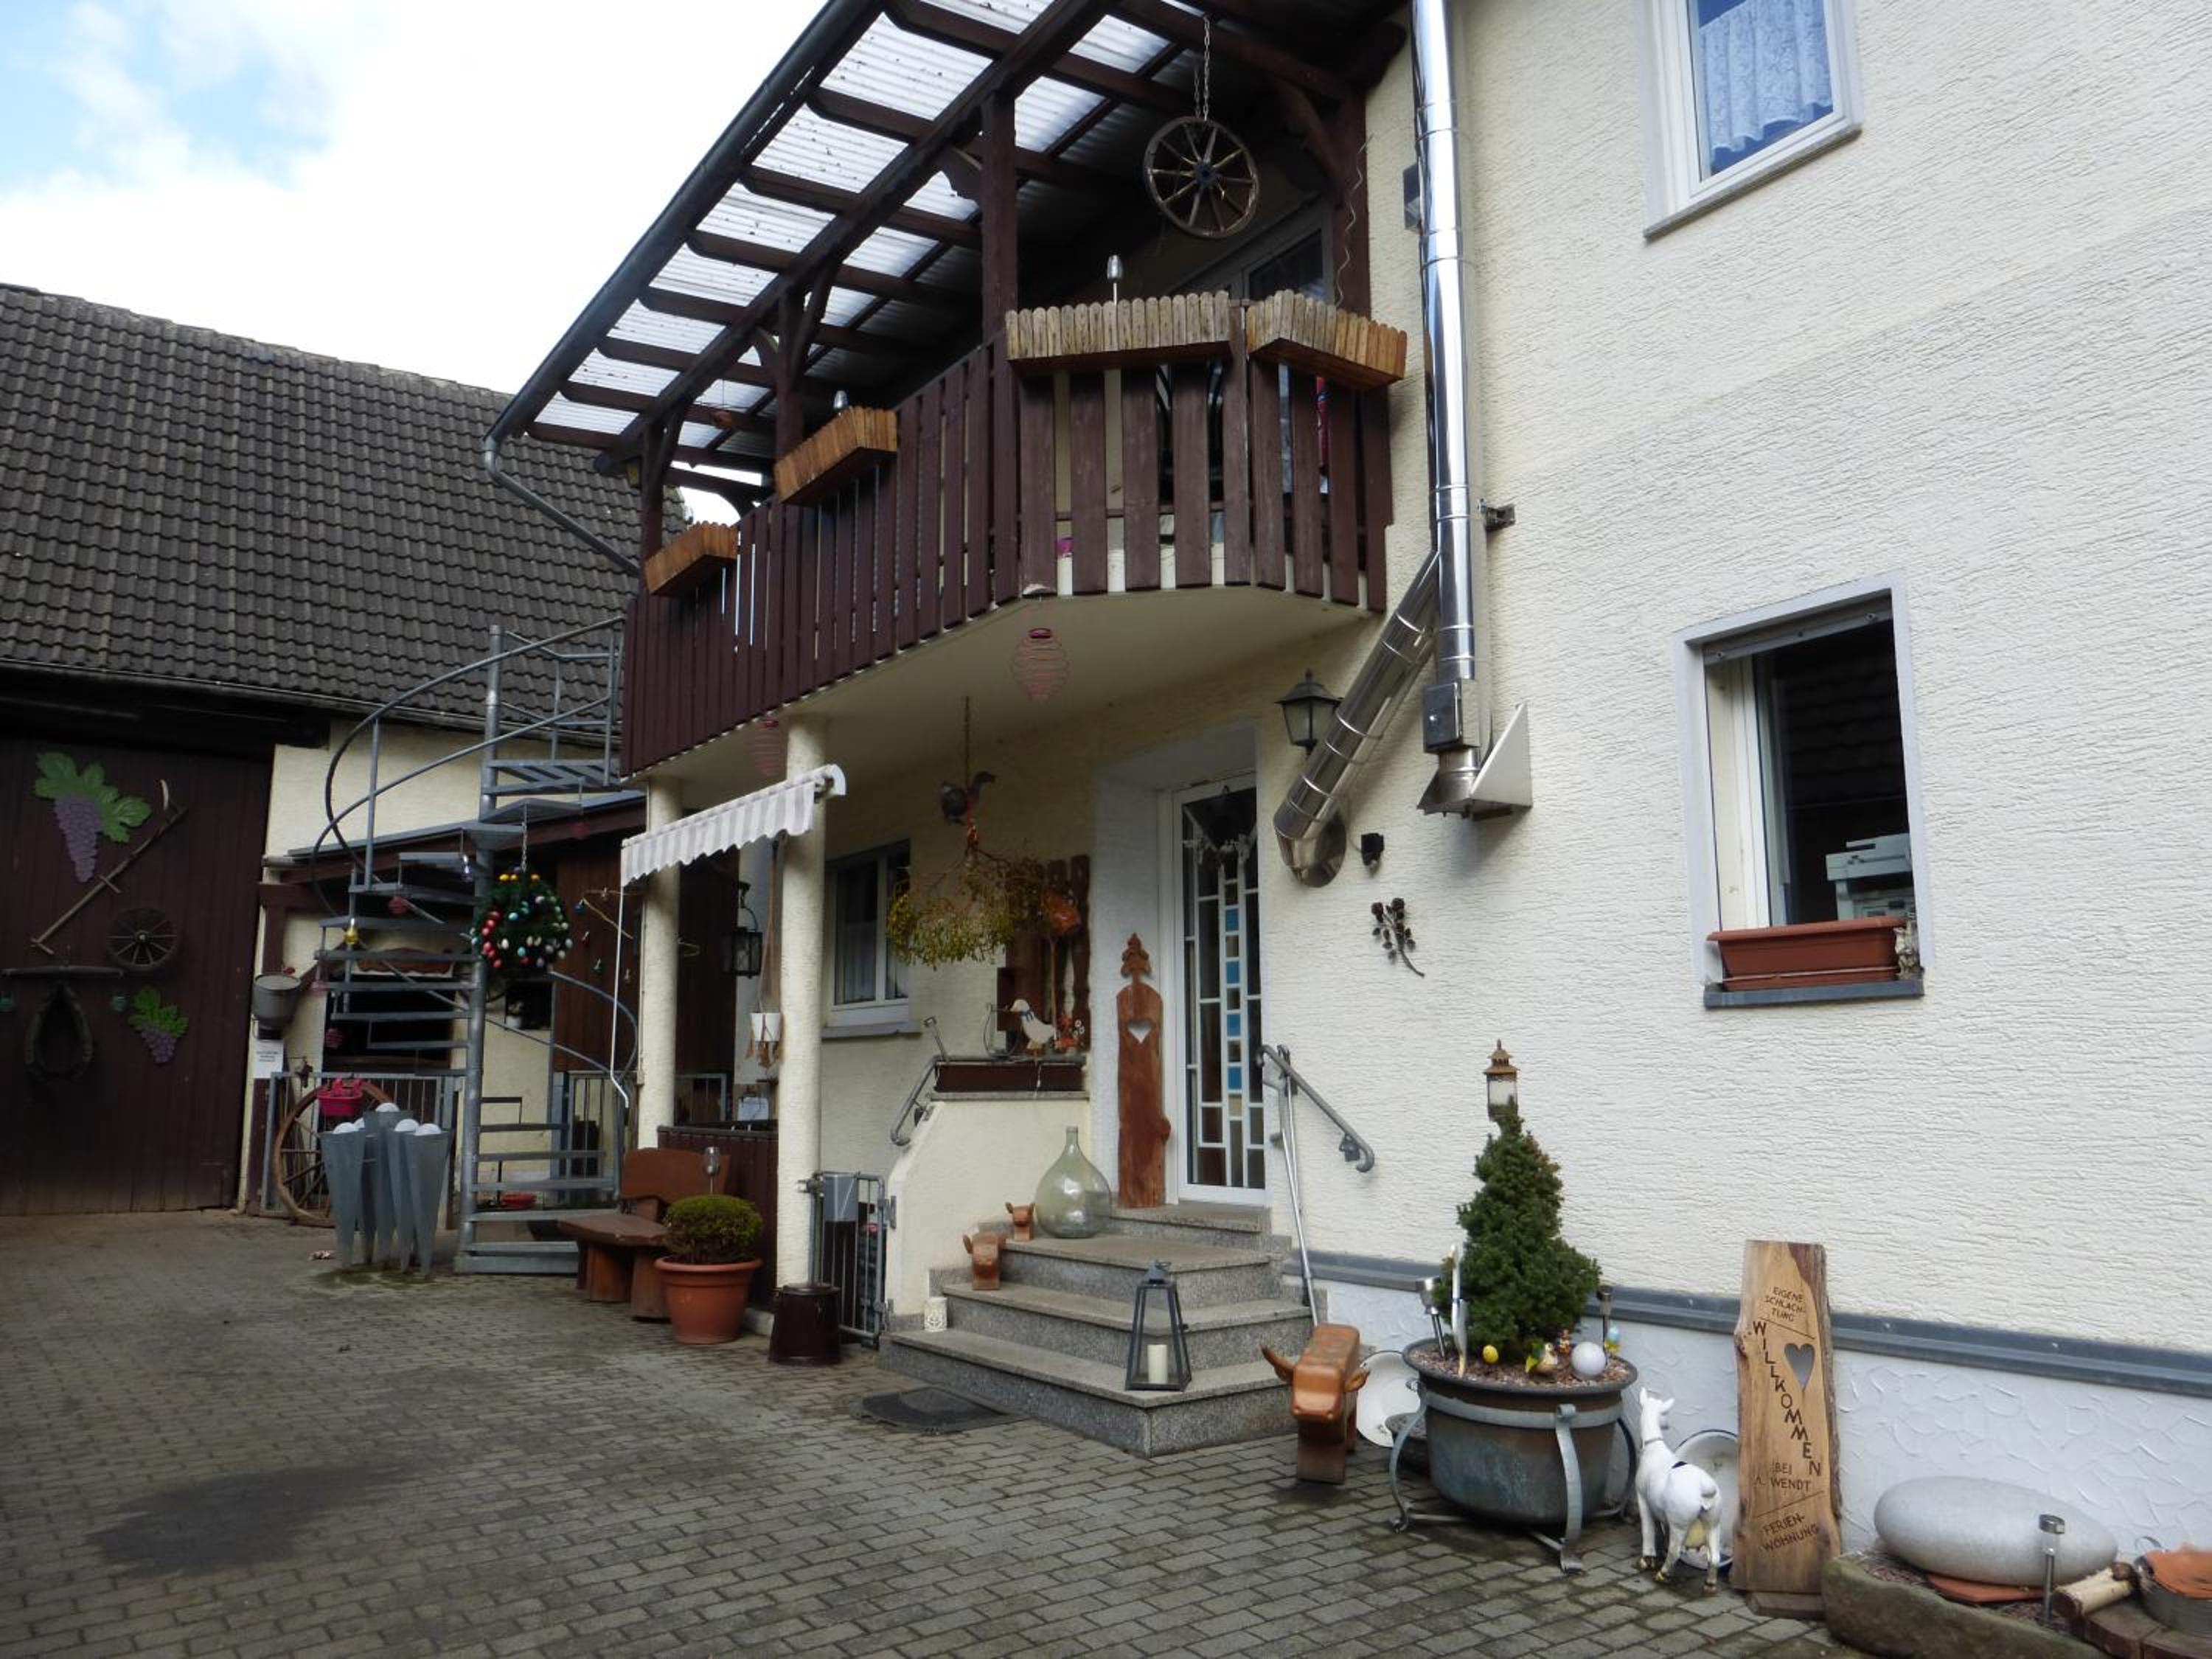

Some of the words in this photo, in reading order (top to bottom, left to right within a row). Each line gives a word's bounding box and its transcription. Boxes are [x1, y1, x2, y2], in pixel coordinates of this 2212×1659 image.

[1773, 1286, 1804, 1303] EIGENE
[1772, 1308, 1794, 1322] TUNG
[1753, 1321, 1821, 1476] WILLKOMMEN
[1773, 1461, 1792, 1475] BEI
[1770, 1476, 1812, 1492] WENDT
[1762, 1523, 1819, 1551] WOHNUNG
